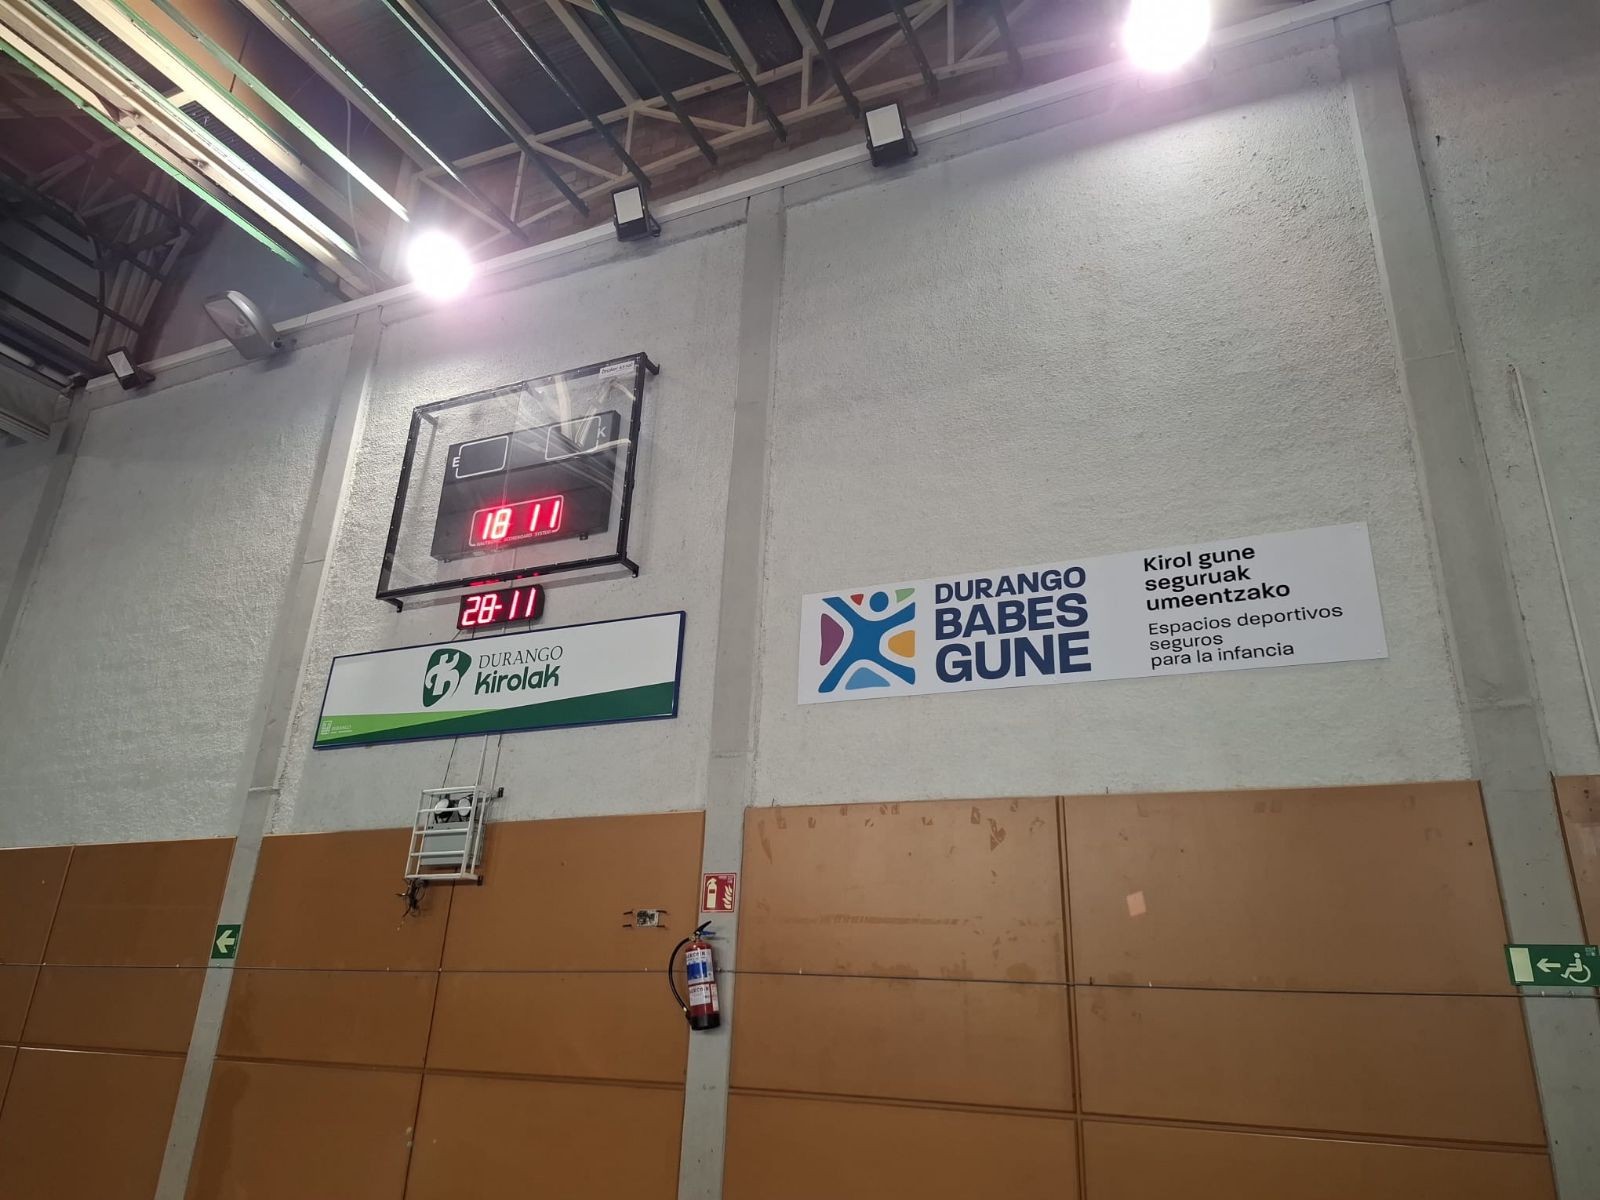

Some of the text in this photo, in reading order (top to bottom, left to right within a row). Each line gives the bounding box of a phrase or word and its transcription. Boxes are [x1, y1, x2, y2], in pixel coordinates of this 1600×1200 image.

[1143, 547, 1255, 572] Kirol gune
[935, 566, 1086, 604] DURANGO
[1144, 565, 1251, 592] seguruak
[461, 587, 537, 627] 28-11
[1146, 583, 1290, 611] umeentzako
[935, 592, 1088, 640] BABES
[1149, 605, 1344, 636] Espacios deportivos
[479, 645, 563, 669] DURANGO
[935, 631, 1092, 683] GUNE
[1149, 634, 1223, 652] seguros
[1151, 642, 1295, 670] para la infancia
